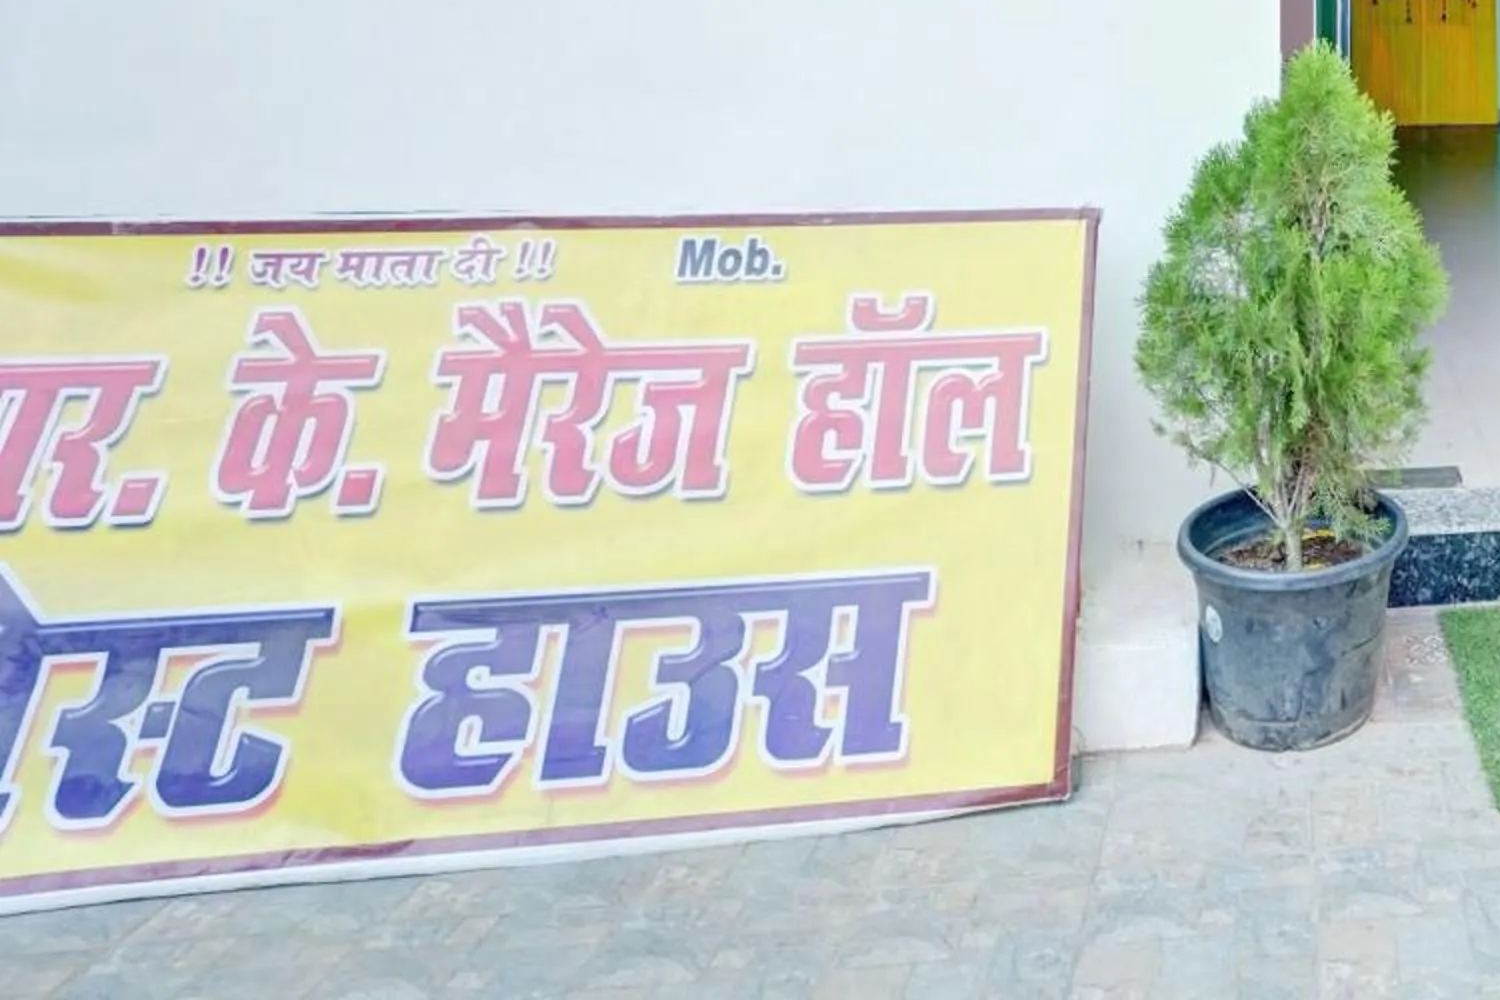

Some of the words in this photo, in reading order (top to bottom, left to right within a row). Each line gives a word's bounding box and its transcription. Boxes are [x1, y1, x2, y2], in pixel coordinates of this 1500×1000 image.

[249, 251, 325, 284] जय
[336, 249, 443, 284] माता
[450, 237, 503, 281] दी
[677, 238, 782, 278] Mob.
[217, 311, 381, 511] के.
[429, 302, 753, 500] मैरेज
[792, 296, 1044, 489] हॉल
[400, 571, 931, 790] हाउस
